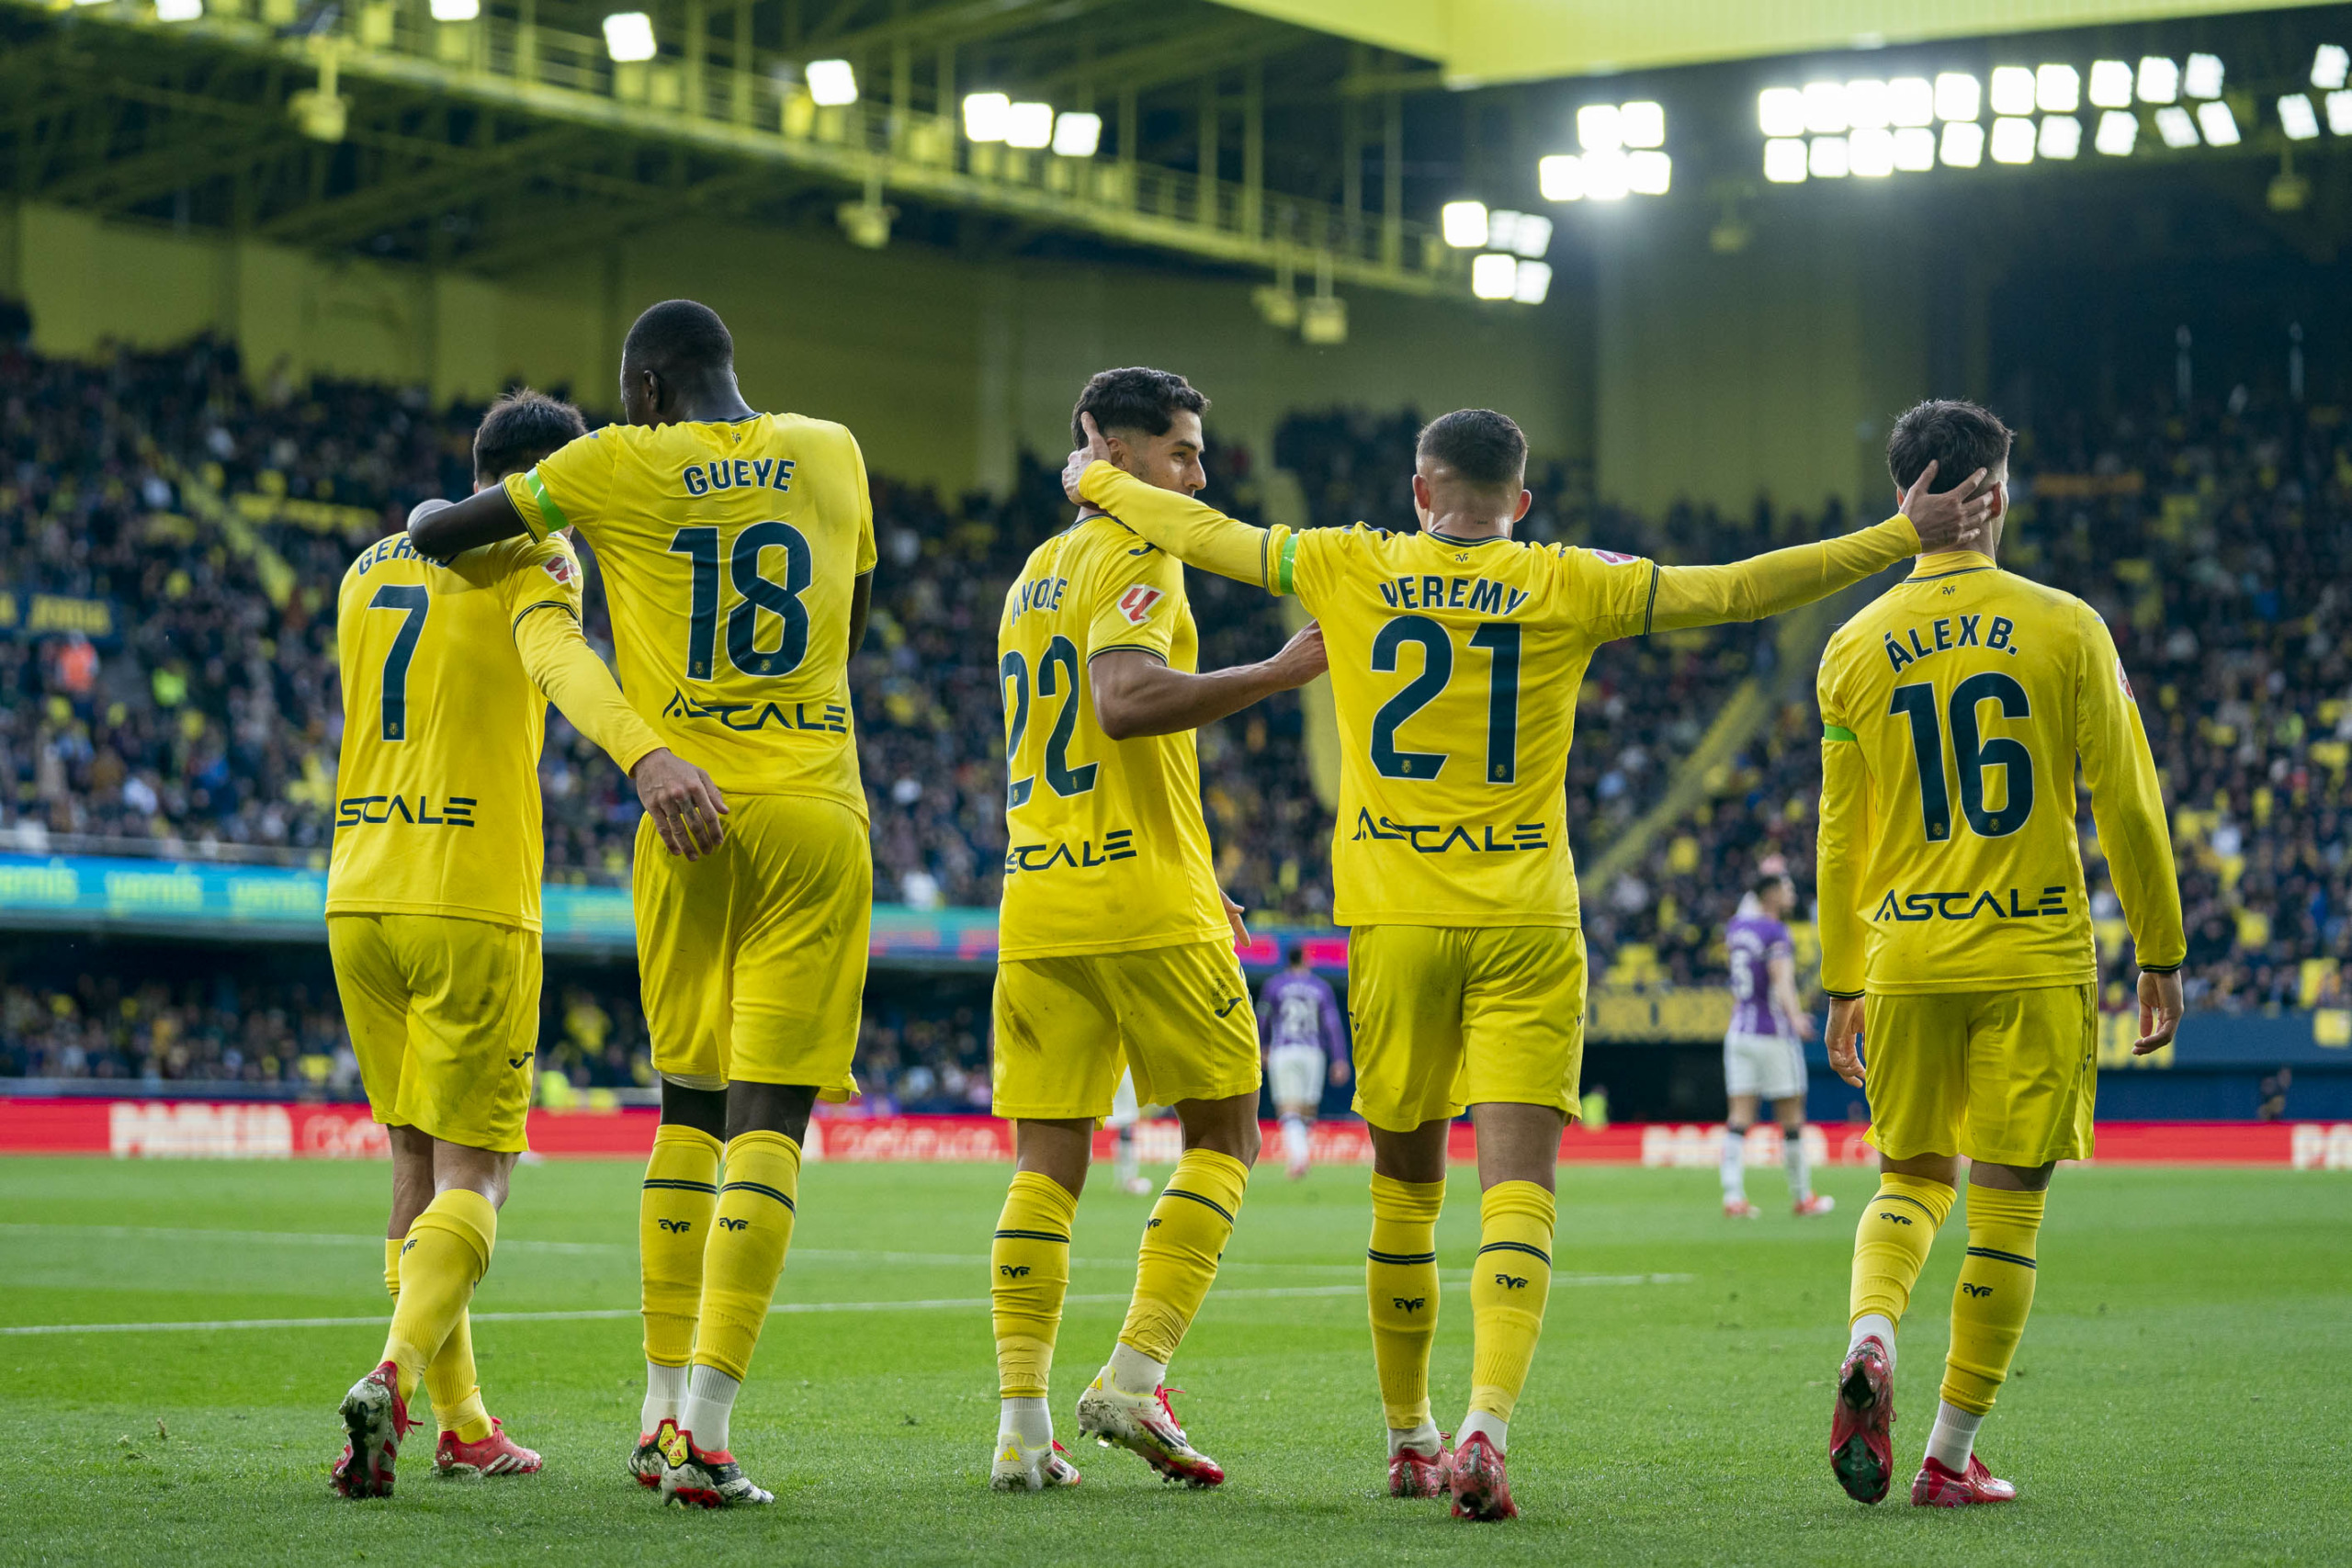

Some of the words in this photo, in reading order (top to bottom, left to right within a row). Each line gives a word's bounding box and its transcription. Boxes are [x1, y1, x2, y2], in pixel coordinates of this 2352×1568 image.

[684, 458, 796, 496] GUEYE
[357, 536, 459, 576] GER
[667, 520, 813, 682] 18
[1378, 575, 1531, 615] YEREMY
[368, 583, 430, 742] 7
[1370, 615, 1522, 784] 21
[1000, 635, 1100, 812] 22
[1887, 671, 2035, 843] 16
[336, 795, 478, 828] SCALE
[1004, 829, 1137, 874] SCALE
[1873, 886, 2068, 922] ASCALE
